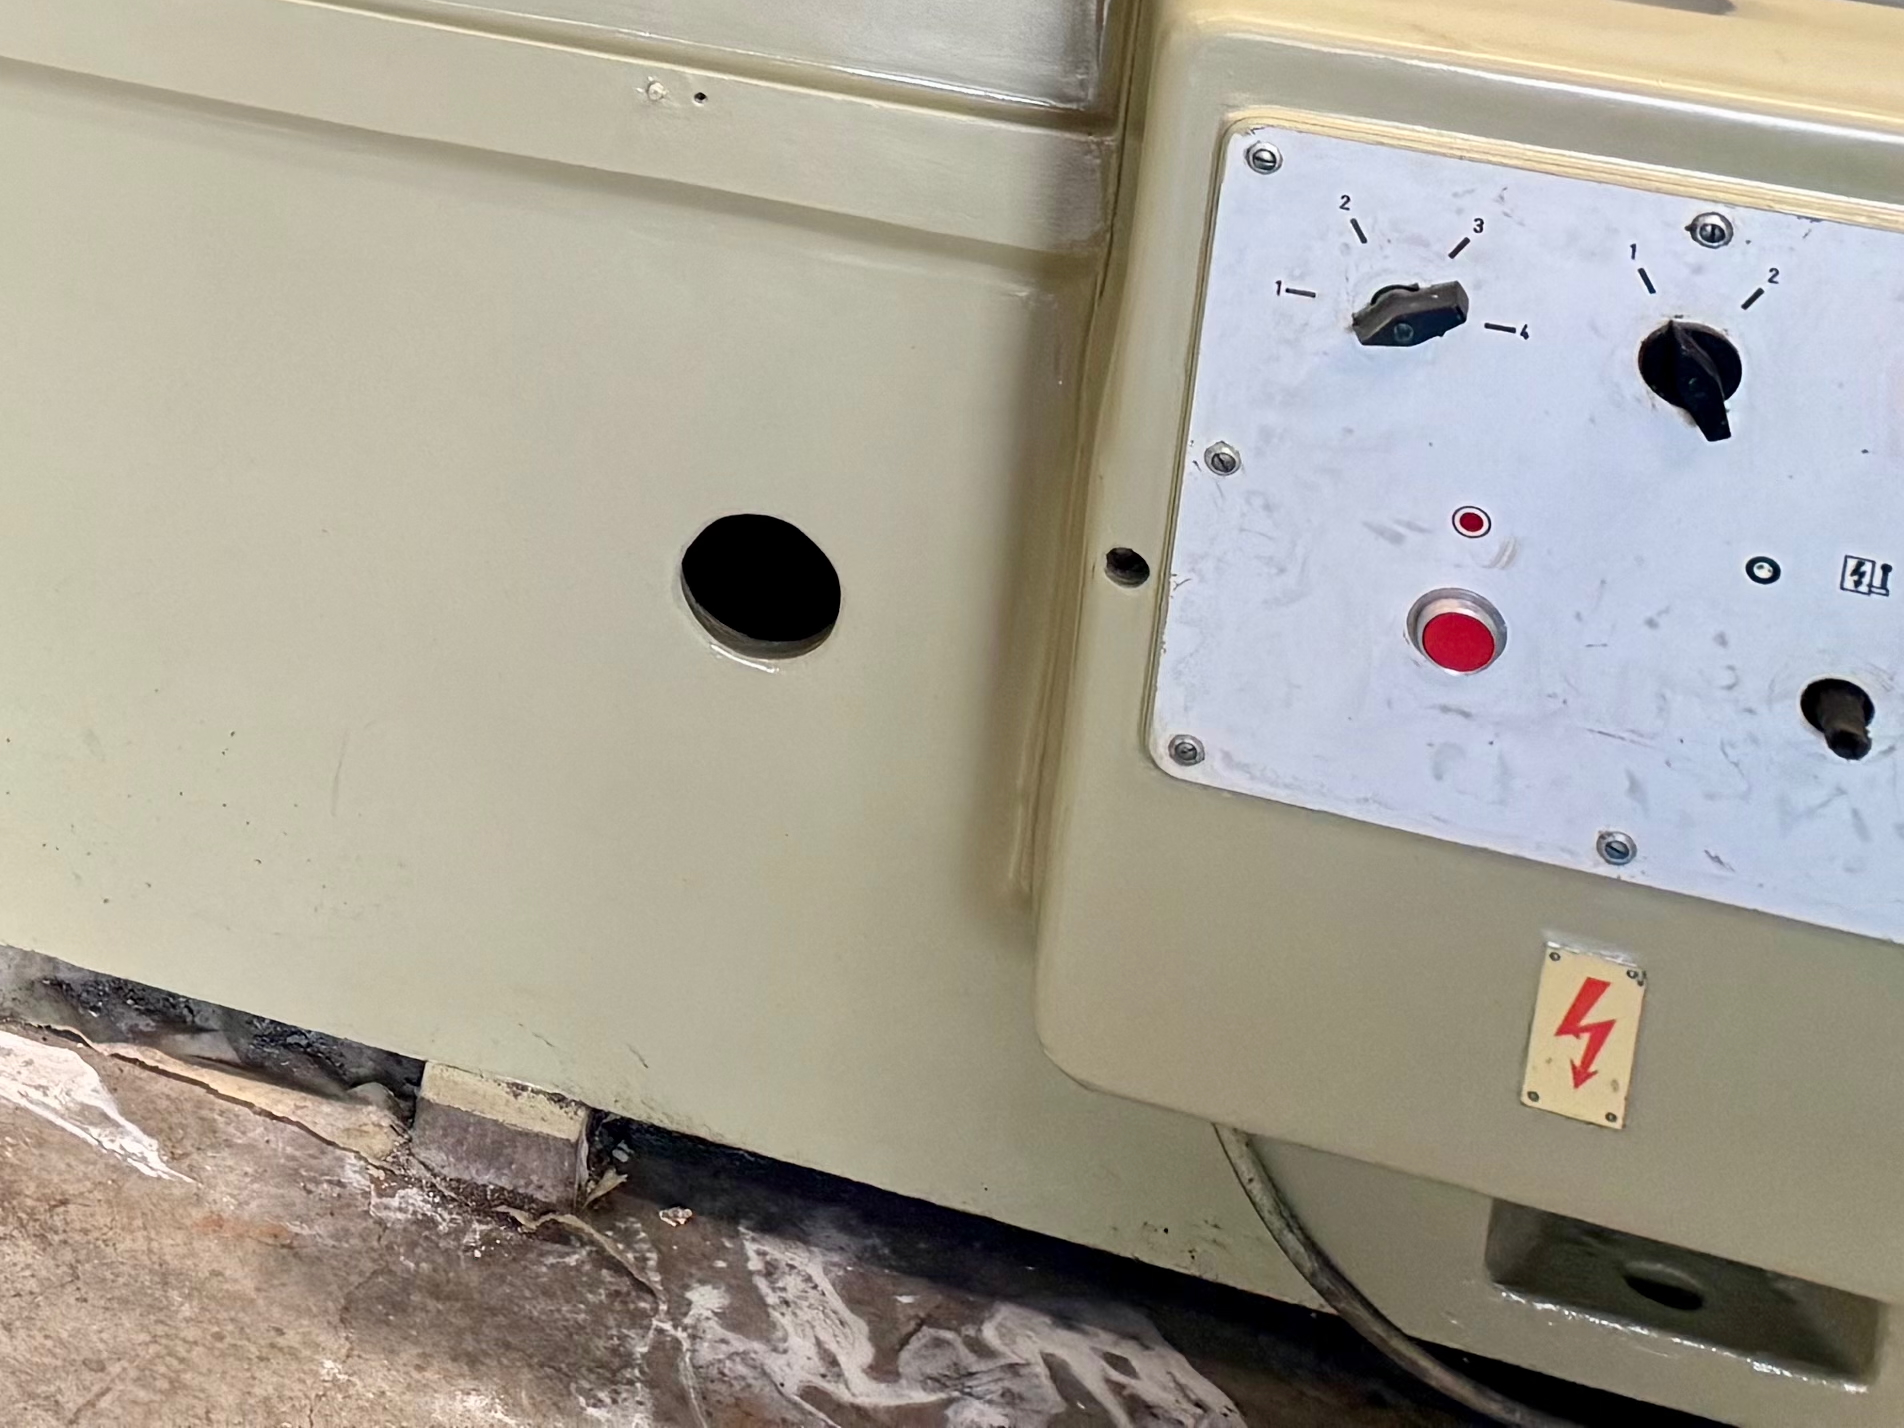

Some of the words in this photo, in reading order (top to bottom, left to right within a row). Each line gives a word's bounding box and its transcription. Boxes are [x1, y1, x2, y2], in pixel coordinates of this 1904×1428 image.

[1338, 193, 1351, 211] 2
[1473, 217, 1485, 234] 3
[1630, 243, 1637, 260] 1
[1767, 267, 1780, 285] 2
[1275, 279, 1282, 296] 1
[1519, 323, 1530, 340] 4
